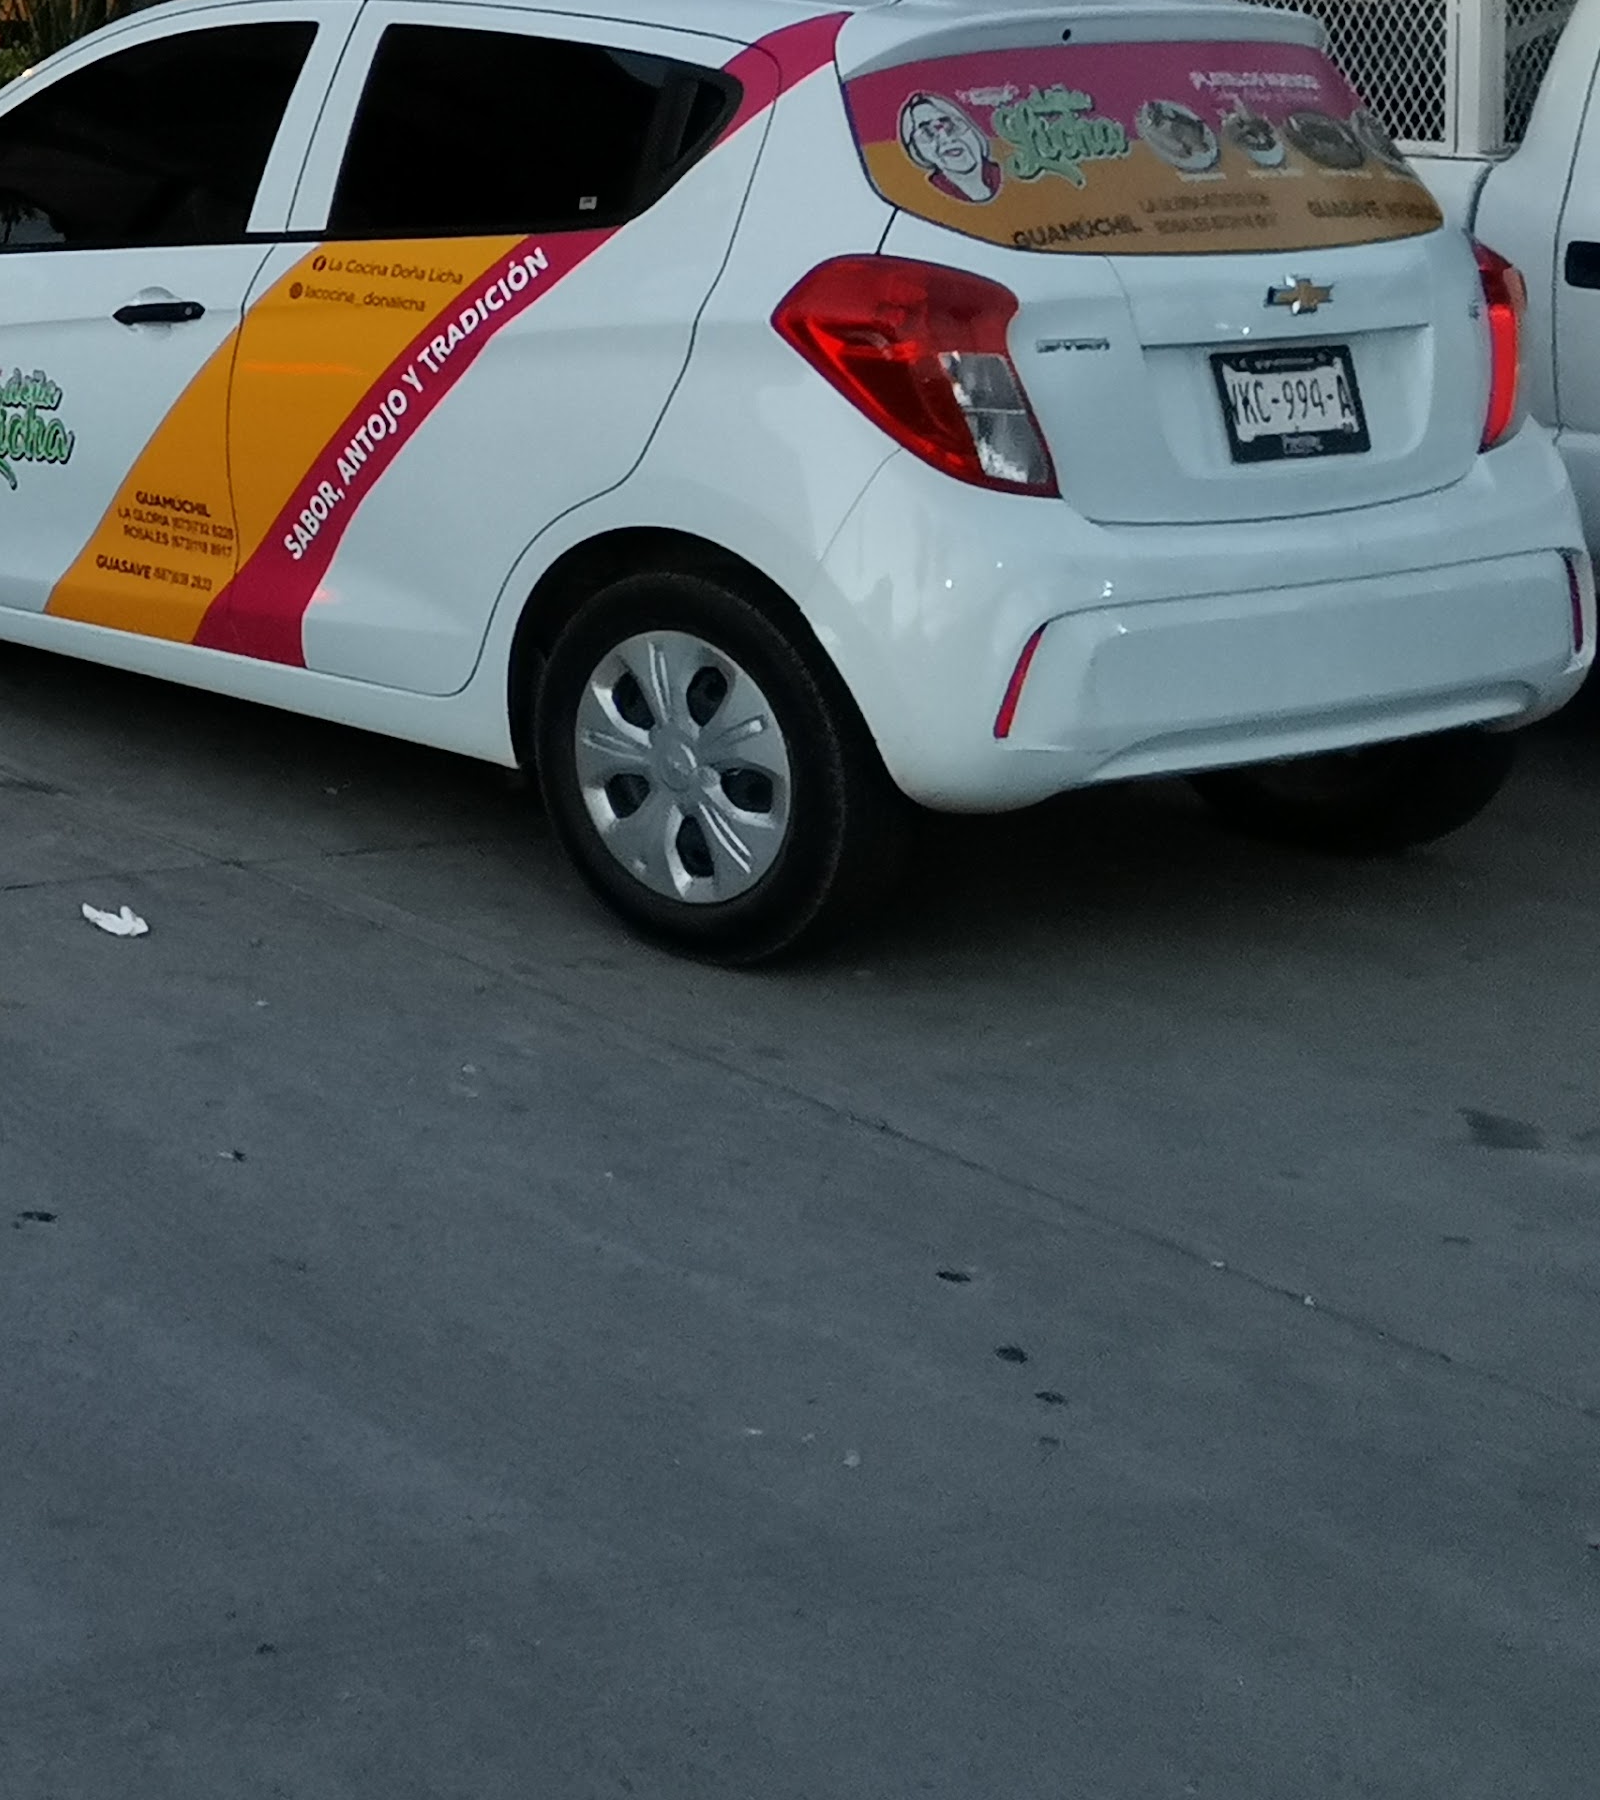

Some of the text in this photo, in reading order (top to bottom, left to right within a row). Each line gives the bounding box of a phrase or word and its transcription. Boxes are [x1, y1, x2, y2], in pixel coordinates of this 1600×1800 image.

[345, 260, 388, 276] Cocina
[428, 267, 464, 285] Licha
[284, 246, 549, 560] SABOR, ANTOJO Y TRADICIÓN
[118, 506, 132, 519] LA
[95, 553, 152, 580] GUASAVE
